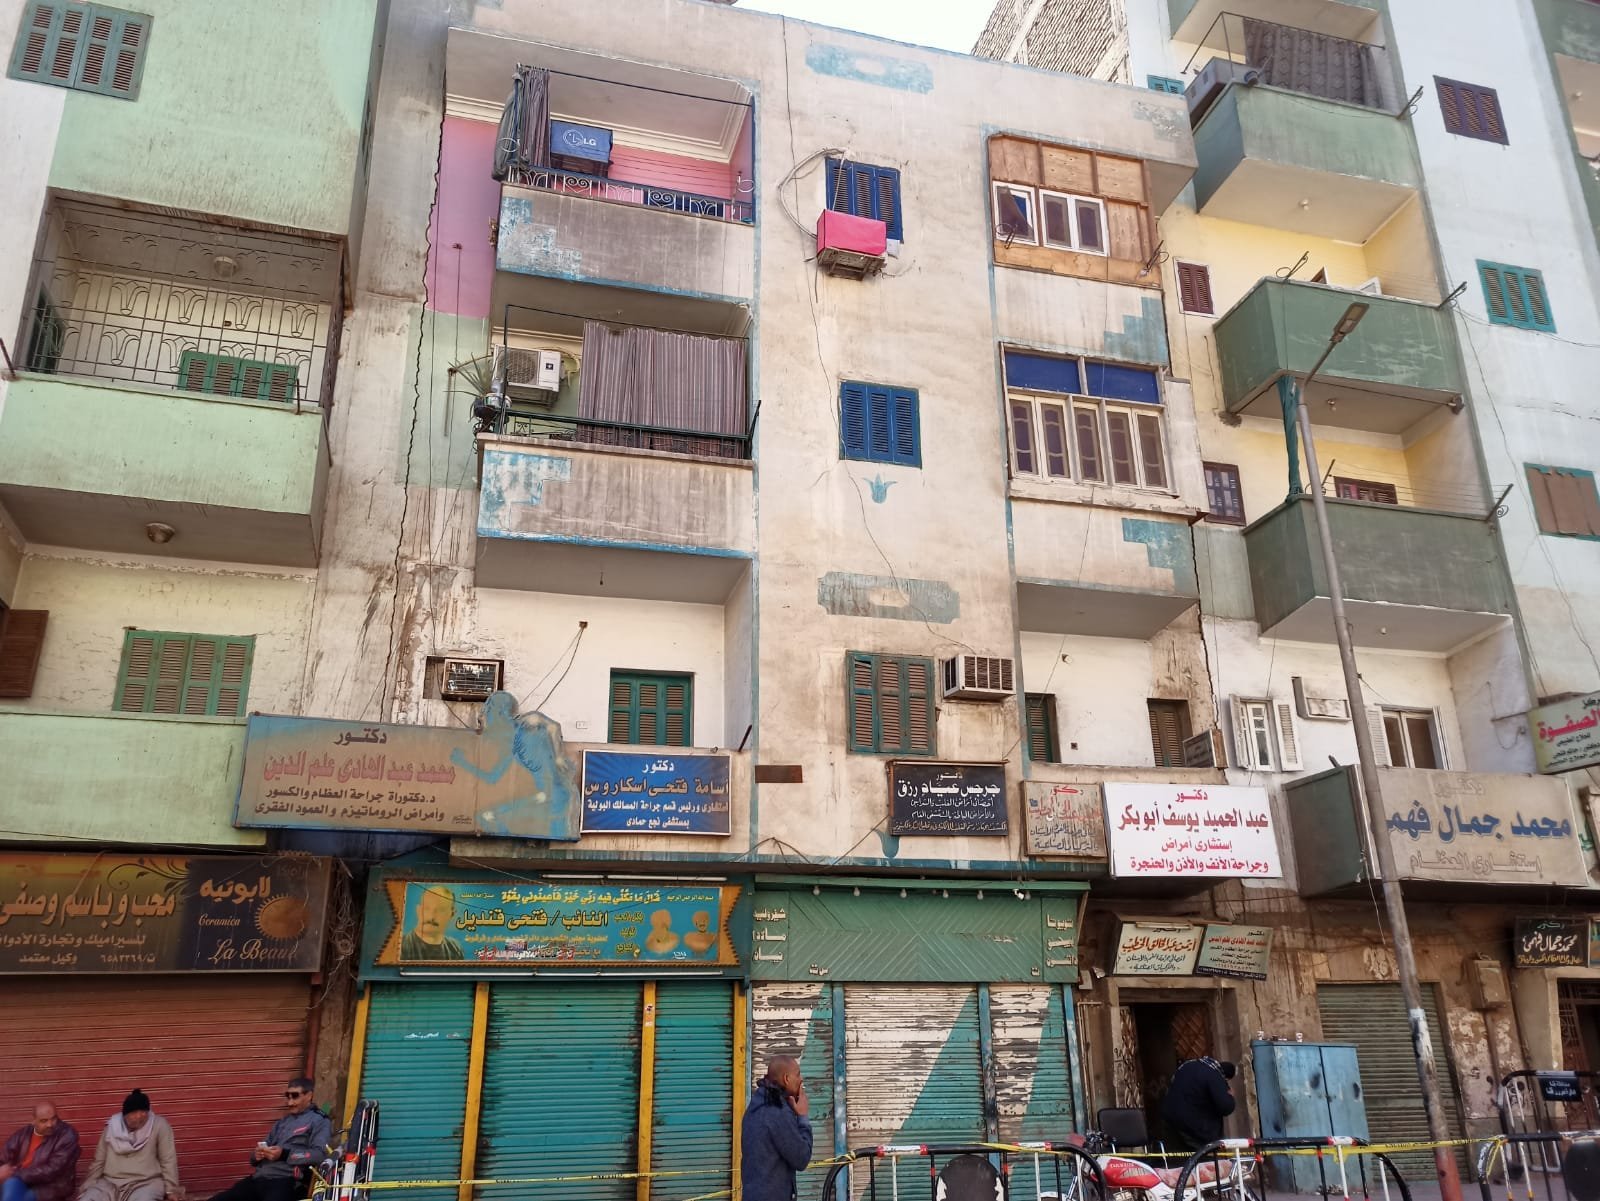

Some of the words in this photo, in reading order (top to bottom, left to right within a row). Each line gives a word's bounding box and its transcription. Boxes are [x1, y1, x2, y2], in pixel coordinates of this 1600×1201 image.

[335, 728, 388, 745] دكتور
[387, 763, 414, 787] عبد
[641, 760, 675, 774] دكتور
[265, 787, 310, 801] والكسور
[648, 778, 689, 797] فتحى
[897, 780, 918, 798] رزق
[922, 780, 960, 798] عياد
[960, 783, 1001, 798] جرجس
[1175, 788, 1209, 802] دكتور
[312, 789, 348, 803] العظام
[351, 791, 385, 804] جراحة
[295, 804, 328, 818] العمود
[340, 804, 402, 819] الروماتيزم
[587, 799, 611, 812] البولية
[612, 799, 639, 810] المسالك
[640, 800, 661, 812] جراحة
[662, 800, 677, 812] قسم
[626, 817, 647, 827] حمادى
[1162, 803, 1200, 832] يوسف
[1203, 807, 1243, 832] الحميد
[1245, 810, 1269, 834] عبد
[1385, 799, 1433, 842] فهم
[1437, 803, 1505, 844] جمال
[1510, 811, 1572, 838] محمد
[1130, 856, 1174, 873] والحنجرة
[1232, 857, 1269, 873] وجراحة
[60, 883, 113, 929] باسم
[131, 893, 176, 927] محب
[198, 912, 241, 928] Ceramica
[456, 908, 506, 931] قنديل
[507, 909, 549, 932] فتحى
[561, 909, 610, 932] النائب
[0, 932, 37, 948] الأدوا
[39, 933, 82, 947] وتجارة
[84, 934, 147, 948] للسيراميك
[18, 952, 51, 964] معتمد
[52, 952, 78, 965] وكيل
[207, 937, 239, 966] La
